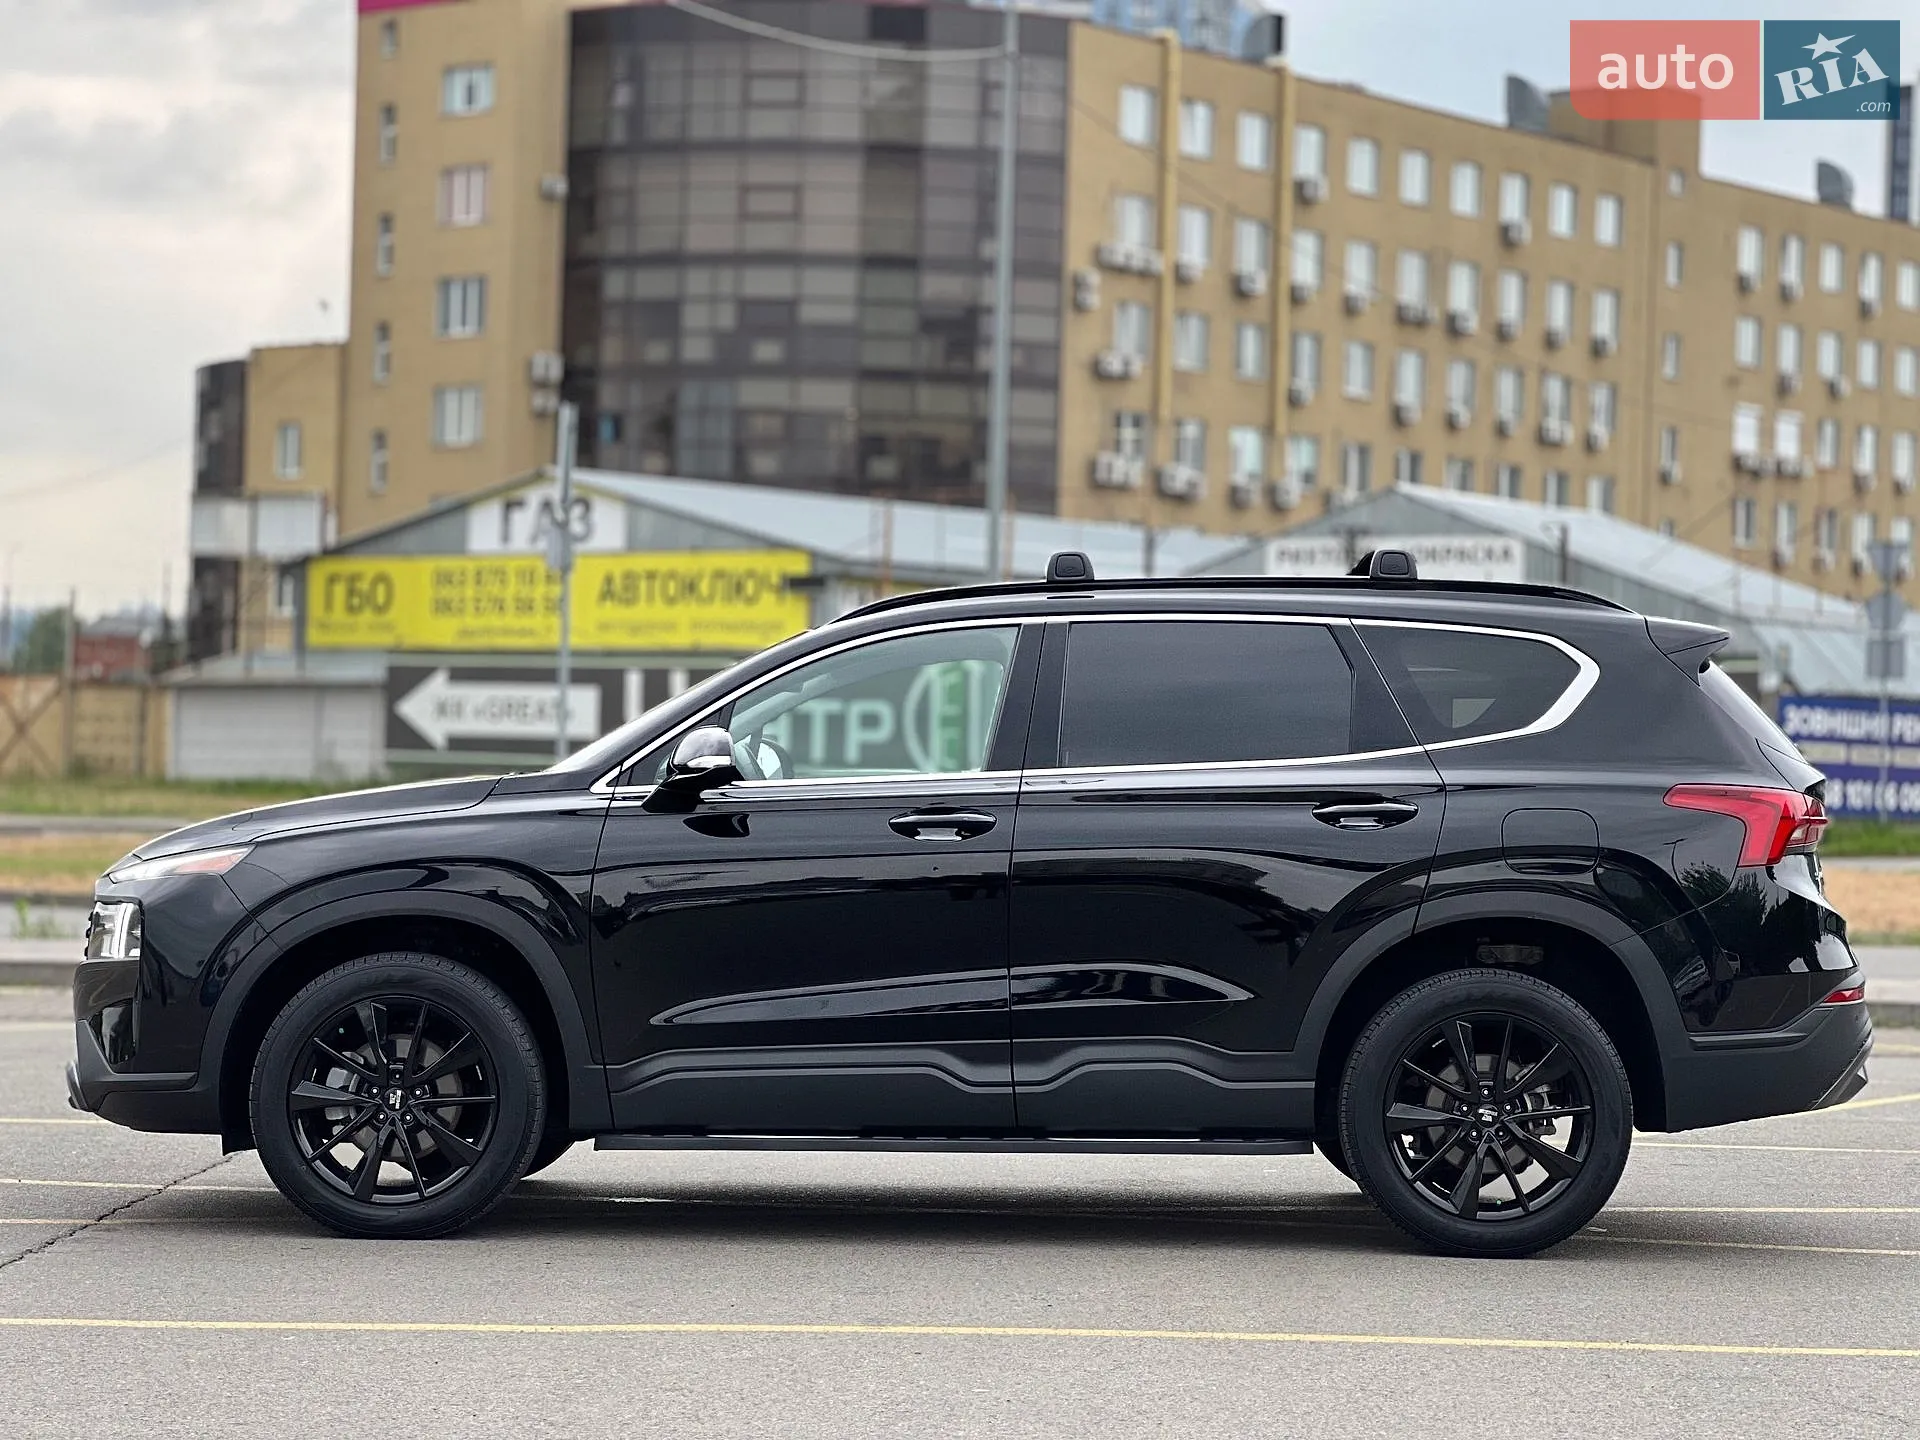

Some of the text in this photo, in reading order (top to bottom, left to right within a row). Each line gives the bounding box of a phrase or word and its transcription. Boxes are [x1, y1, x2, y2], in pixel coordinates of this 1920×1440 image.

[501, 497, 593, 544] ГАЗ
[324, 571, 395, 616] ГБО
[597, 569, 787, 608] АВТОКЛЮЧ
